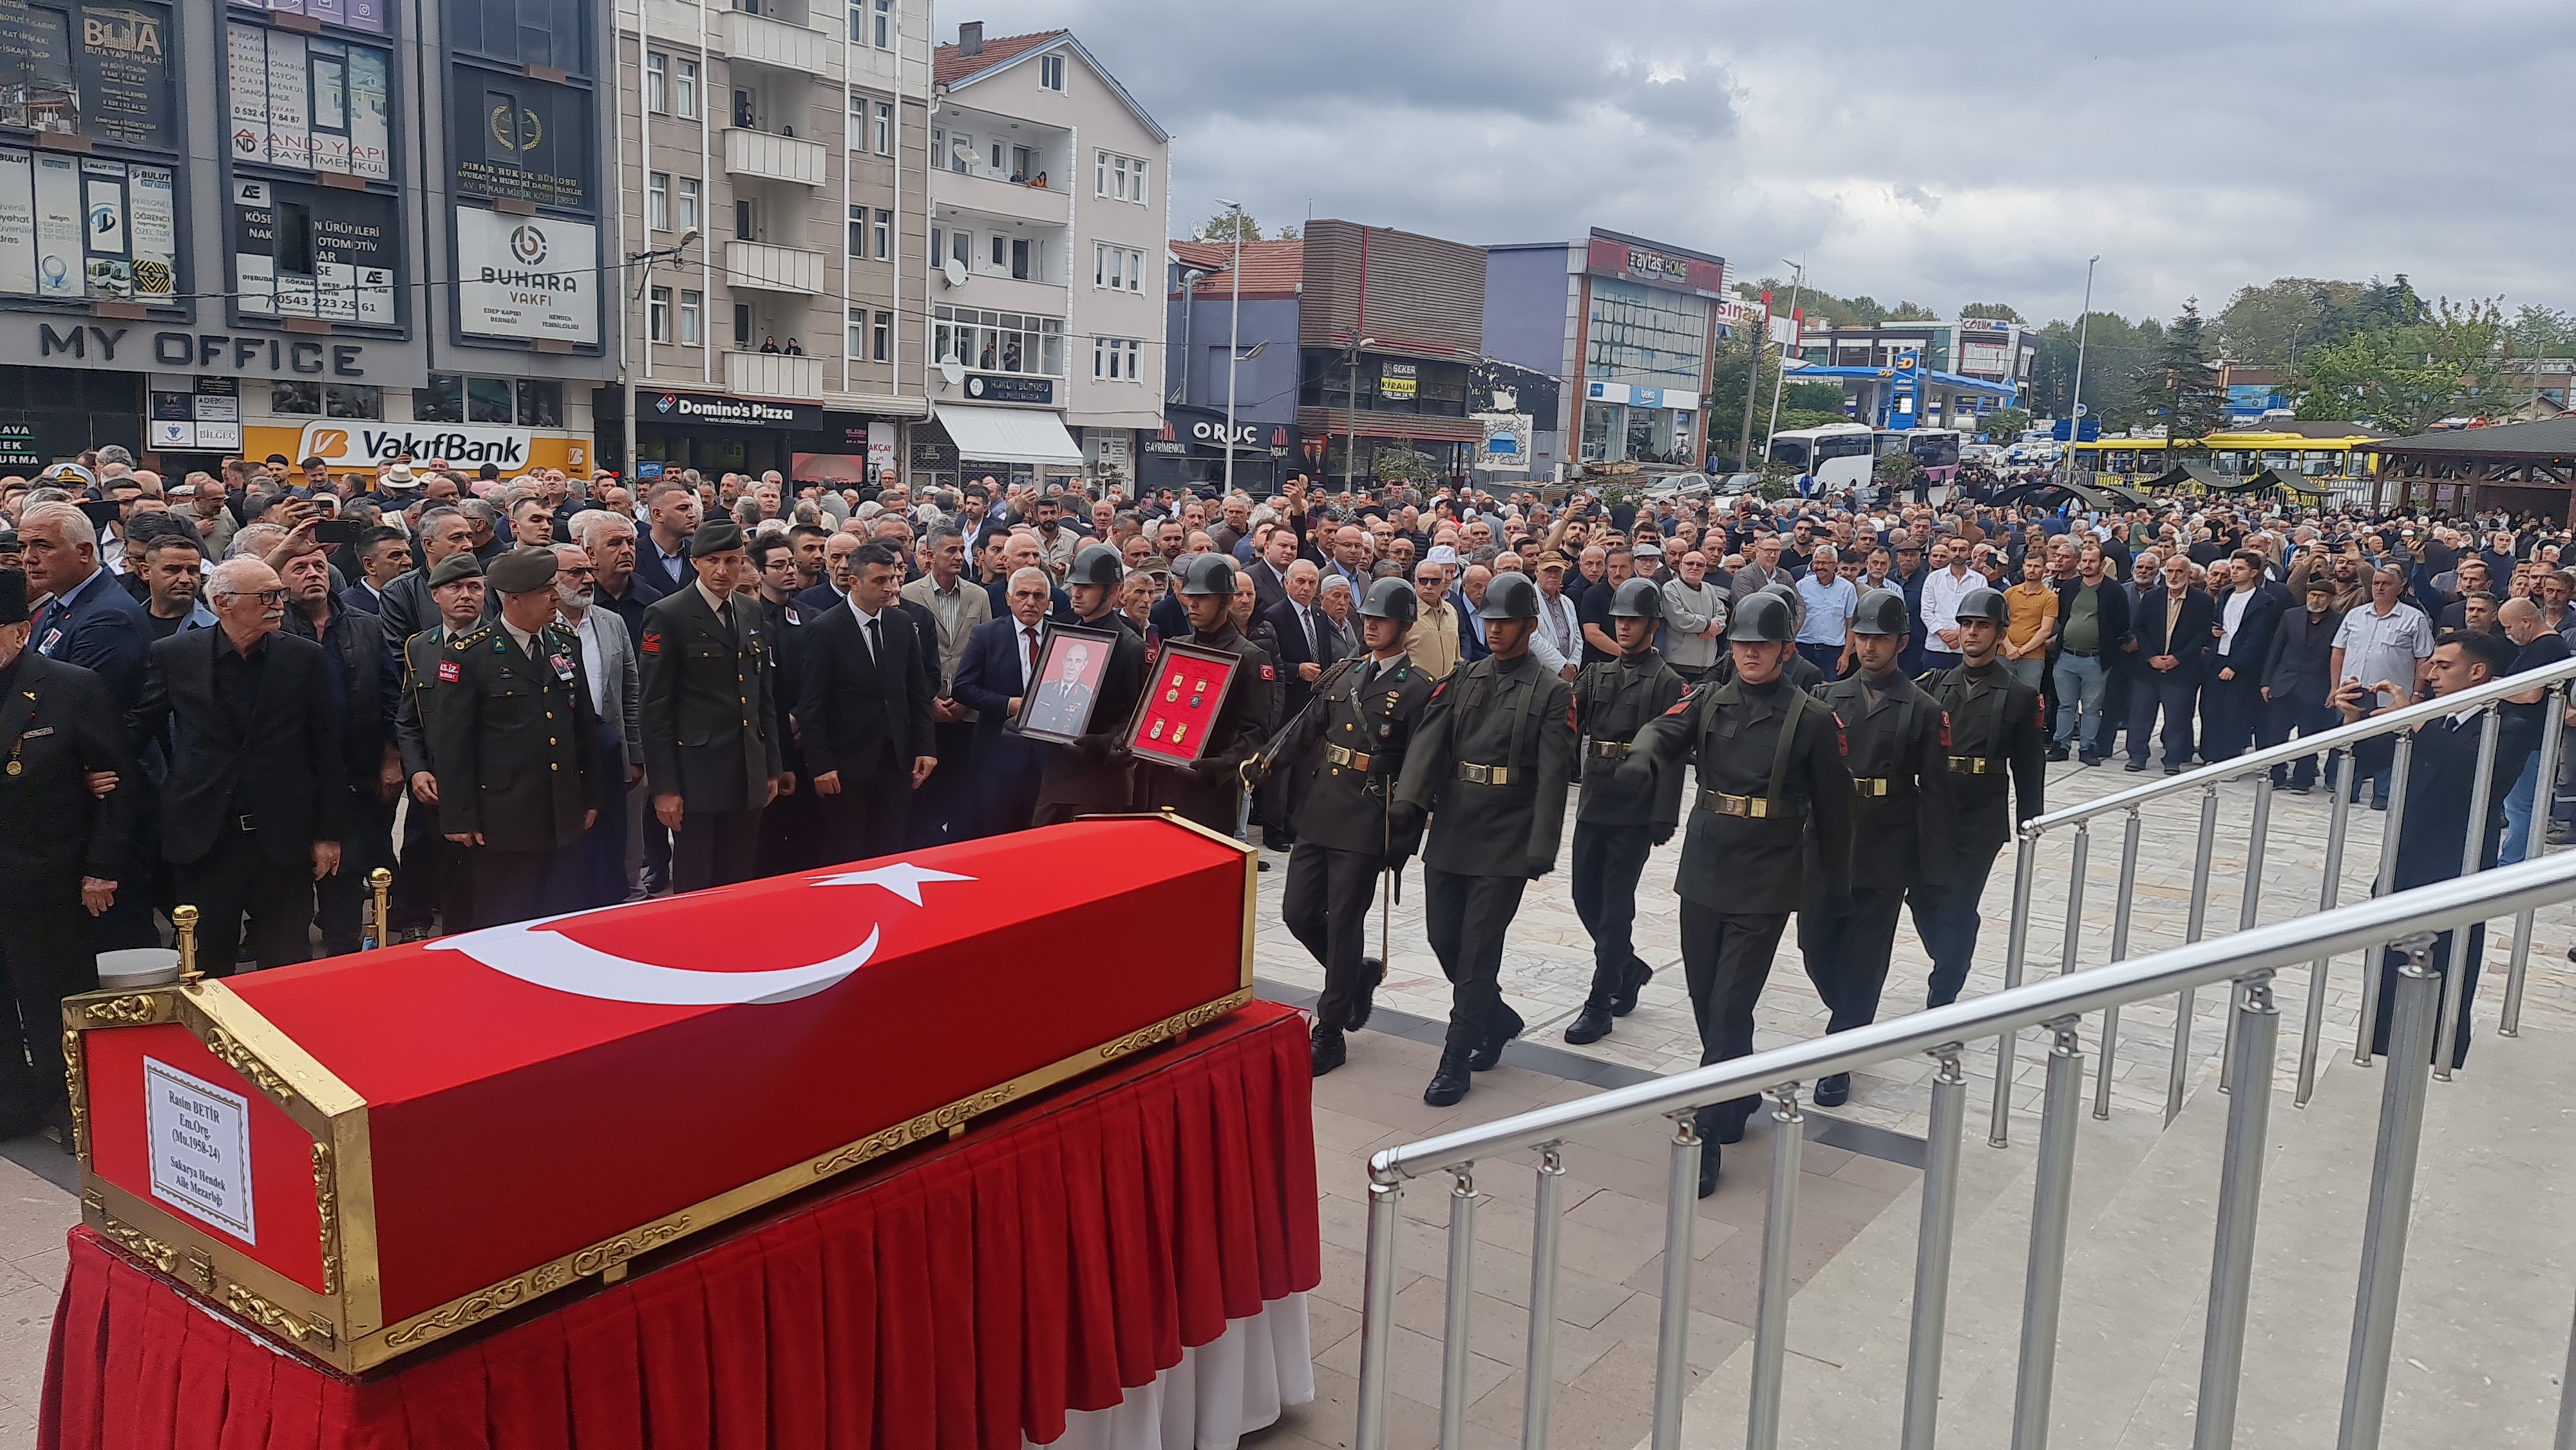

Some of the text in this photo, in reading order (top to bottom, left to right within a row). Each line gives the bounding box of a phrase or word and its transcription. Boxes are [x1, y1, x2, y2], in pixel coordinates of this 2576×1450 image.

[242, 108, 258, 117] 532
[278, 113, 289, 122] 84
[262, 133, 385, 161] AND YAPI
[142, 171, 170, 181] BULUT
[462, 162, 495, 174] PINAR
[498, 167, 535, 181] HUKUK
[317, 237, 378, 252] OTOMOTİV
[1665, 259, 1687, 276] HOME
[482, 267, 576, 293] BUHARA
[277, 295, 308, 306] 0543
[341, 301, 356, 310] 25
[362, 303, 375, 312] 61
[509, 291, 551, 307] VAKFI
[40, 323, 365, 376] MY OFFICE
[1382, 379, 1416, 391] KİRALIK
[679, 399, 793, 420] Domino's Pizza
[0, 426, 30, 435] AVA
[1193, 422, 1258, 445] ORUÇ
[0, 441, 22, 450] EK
[363, 430, 524, 463] VakıfBank
[869, 443, 892, 453] AKÇAY
[1145, 440, 1186, 455] GAYRİMENKUL
[169, 1090, 220, 1124] Rasim BETİR
[179, 1113, 211, 1141] Em.Org.
[173, 1129, 220, 1163] (Mu.1958-24)
[170, 1156, 226, 1192] Sakarya Hendek
[175, 1174, 223, 1208] Aile Mezarlığı
